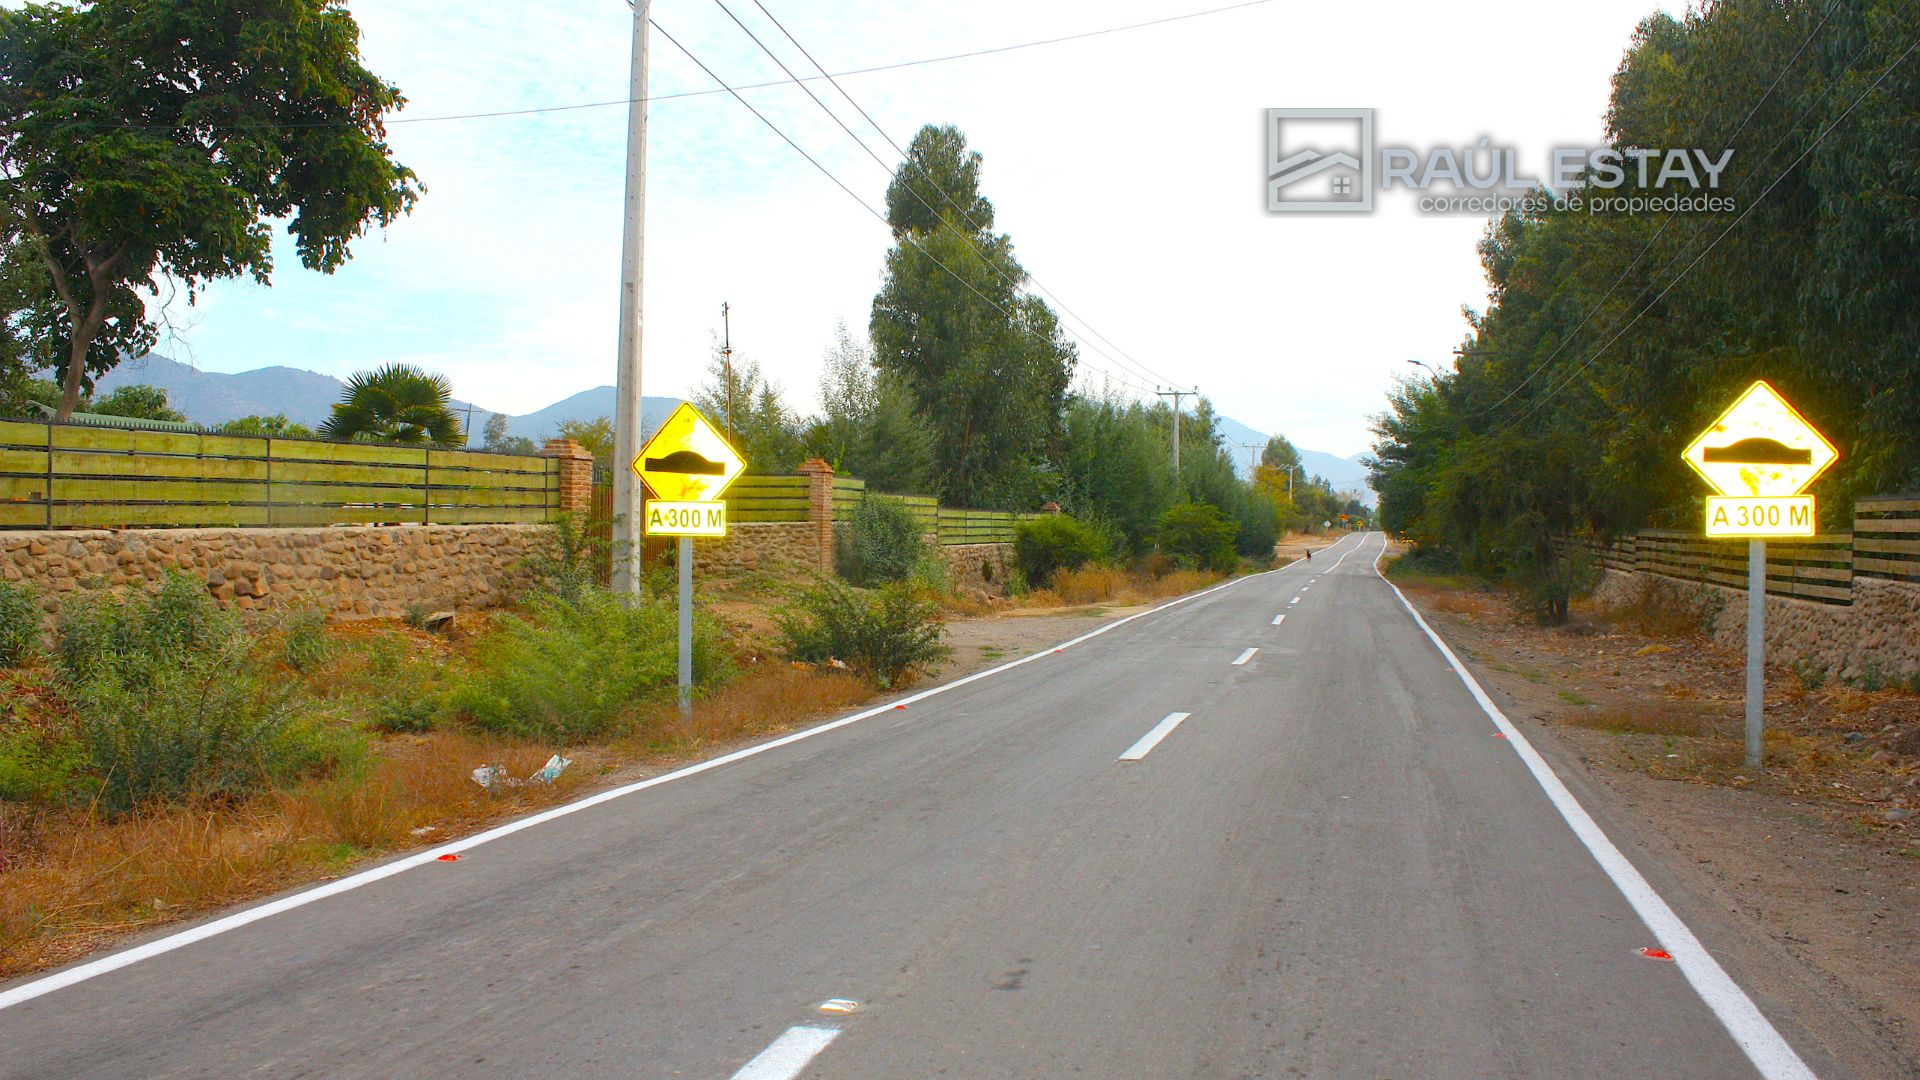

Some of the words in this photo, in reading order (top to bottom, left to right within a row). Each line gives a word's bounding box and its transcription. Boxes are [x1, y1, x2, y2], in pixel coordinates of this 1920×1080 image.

[649, 508, 662, 527] A
[668, 508, 701, 528] 300
[707, 509, 722, 528] M
[1712, 505, 1729, 527] A
[1736, 504, 1780, 527] 300
[1789, 505, 1809, 526] M
